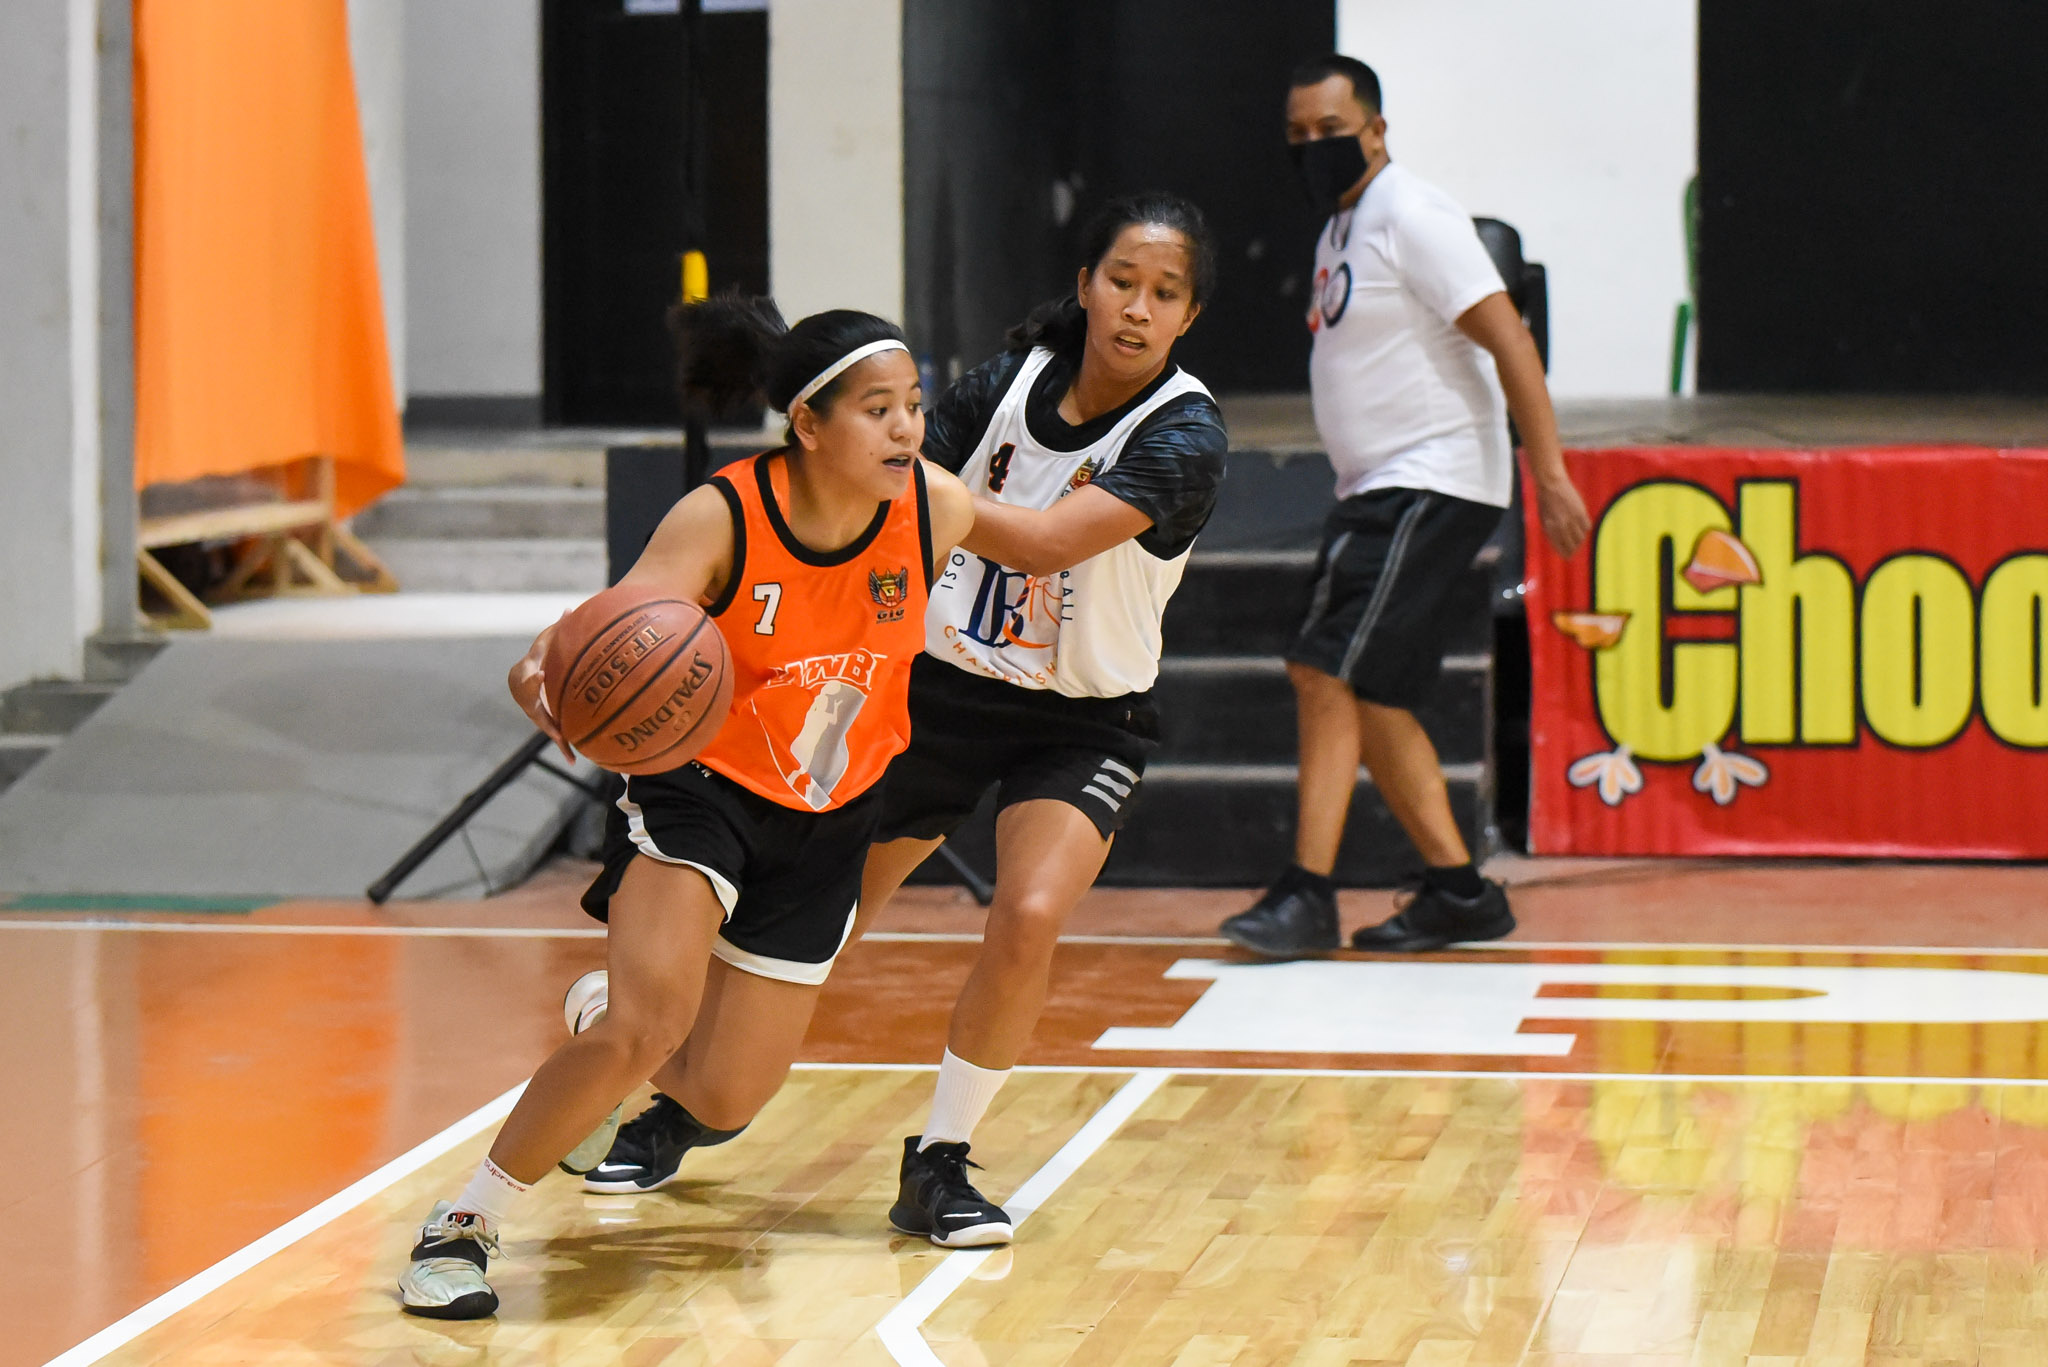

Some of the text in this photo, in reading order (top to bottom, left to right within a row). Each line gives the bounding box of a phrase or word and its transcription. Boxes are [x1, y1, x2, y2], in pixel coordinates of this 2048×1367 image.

[988, 441, 1017, 495] 4
[753, 582, 783, 637] 7
[614, 651, 713, 752] SPALDING
[484, 1158, 526, 1192] Supreme
